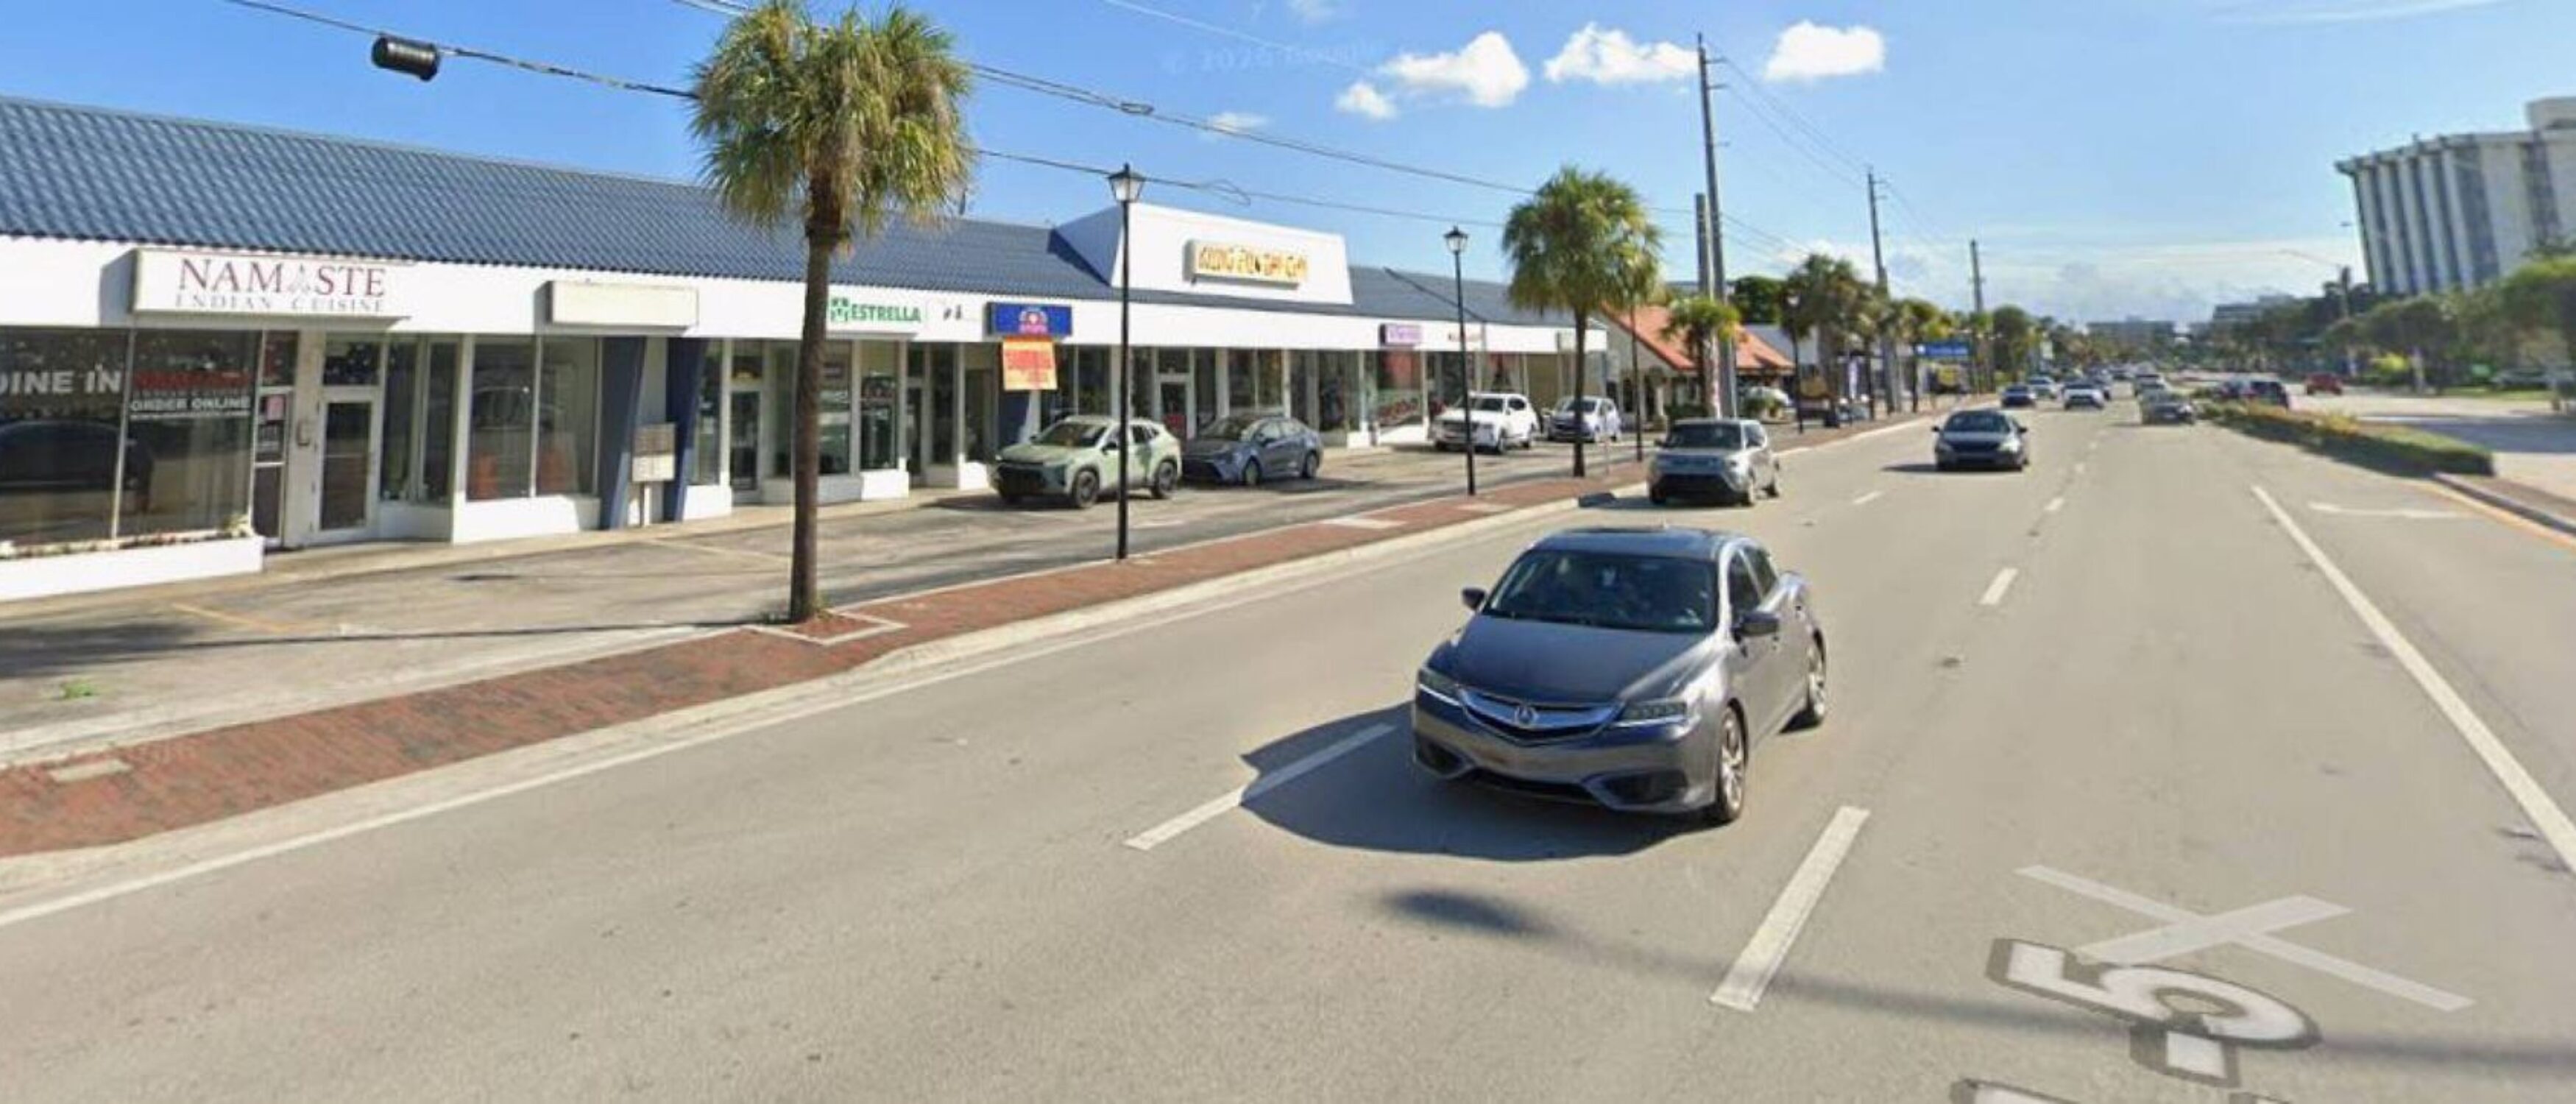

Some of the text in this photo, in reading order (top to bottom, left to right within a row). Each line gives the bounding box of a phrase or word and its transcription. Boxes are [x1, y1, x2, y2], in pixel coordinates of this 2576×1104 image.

[175, 294, 384, 312] INDIAN CUISINE
[852, 302, 921, 322] ESTRELLA
[84, 369, 122, 393] IN
[191, 395, 251, 410] ONLINE
